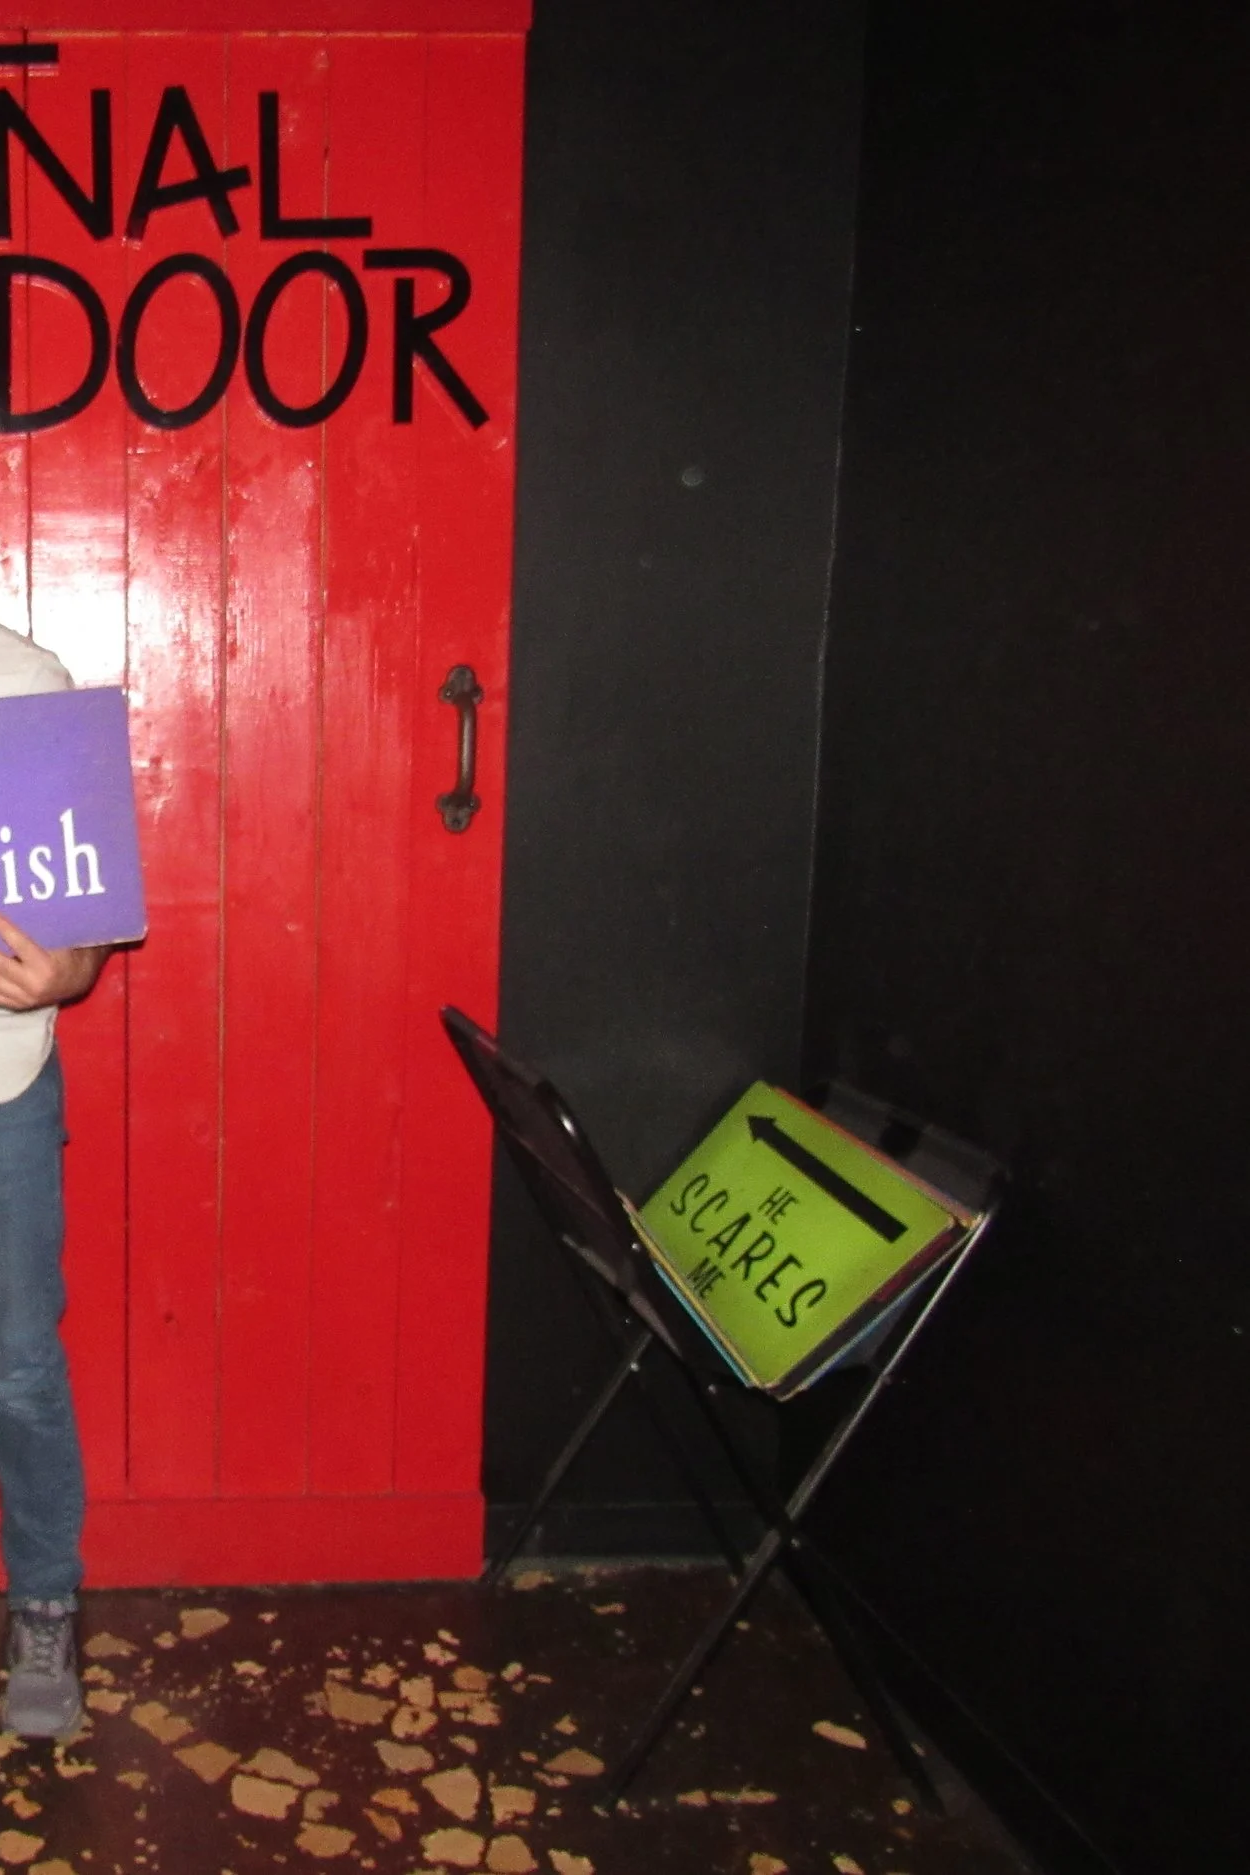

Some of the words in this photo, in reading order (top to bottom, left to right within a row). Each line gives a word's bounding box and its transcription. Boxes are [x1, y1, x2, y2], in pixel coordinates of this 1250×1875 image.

[758, 1186, 799, 1226] HE
[670, 1173, 827, 1328] SCARES
[686, 1257, 727, 1300] ME
